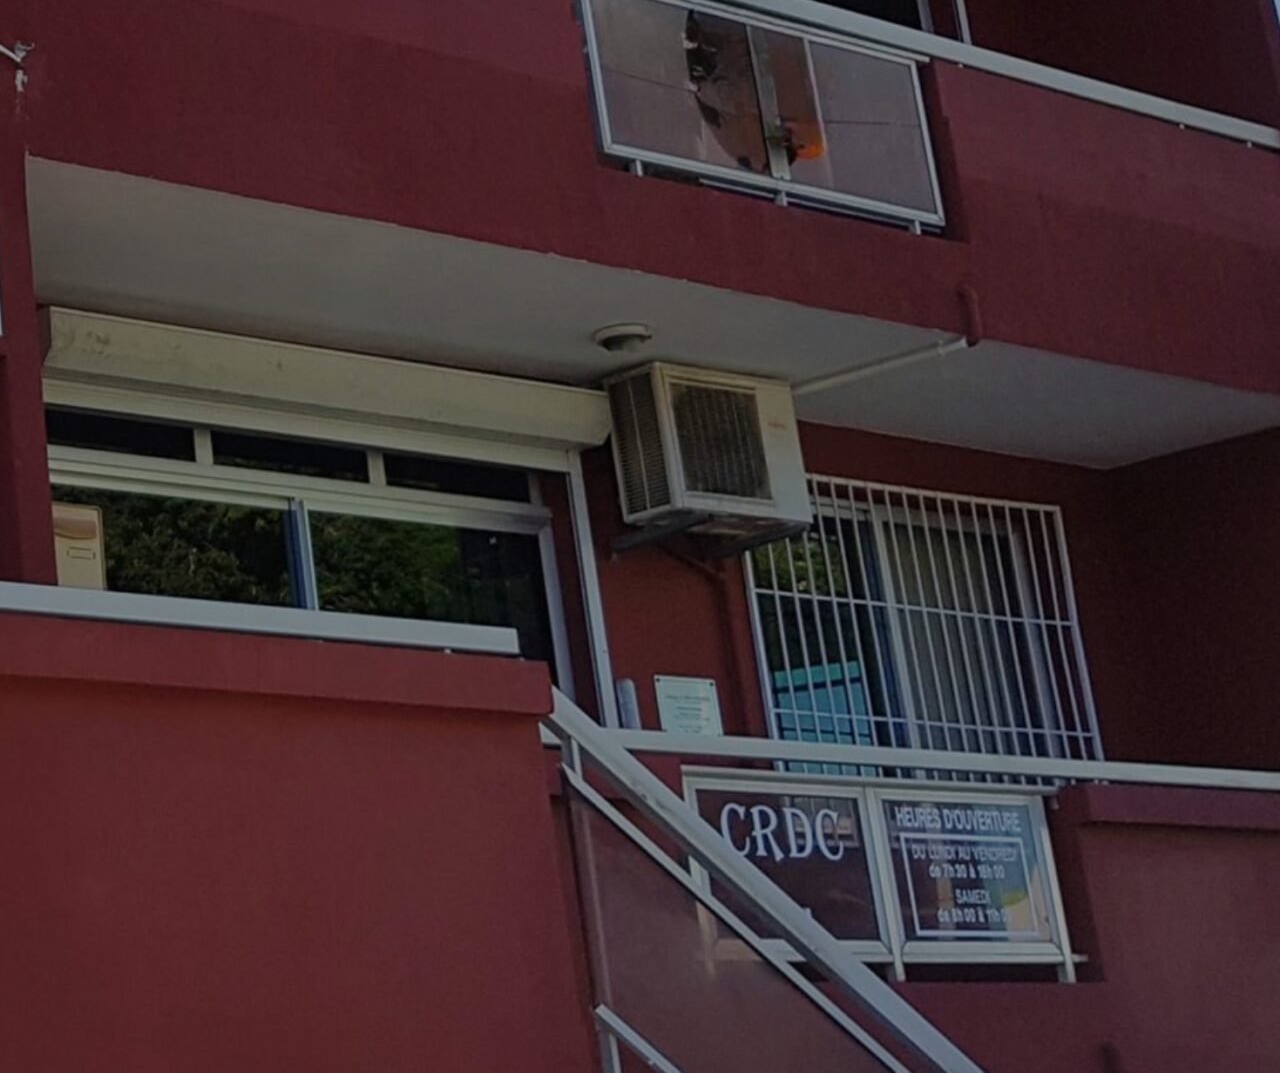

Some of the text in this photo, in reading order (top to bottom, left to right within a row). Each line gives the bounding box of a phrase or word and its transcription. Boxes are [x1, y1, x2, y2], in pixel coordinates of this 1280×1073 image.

[894, 807, 942, 829] HEURES
[720, 802, 844, 862] CRDC
[911, 844, 926, 859] DU
[957, 846, 970, 860] AU
[955, 888, 991, 905] SAMEDI
